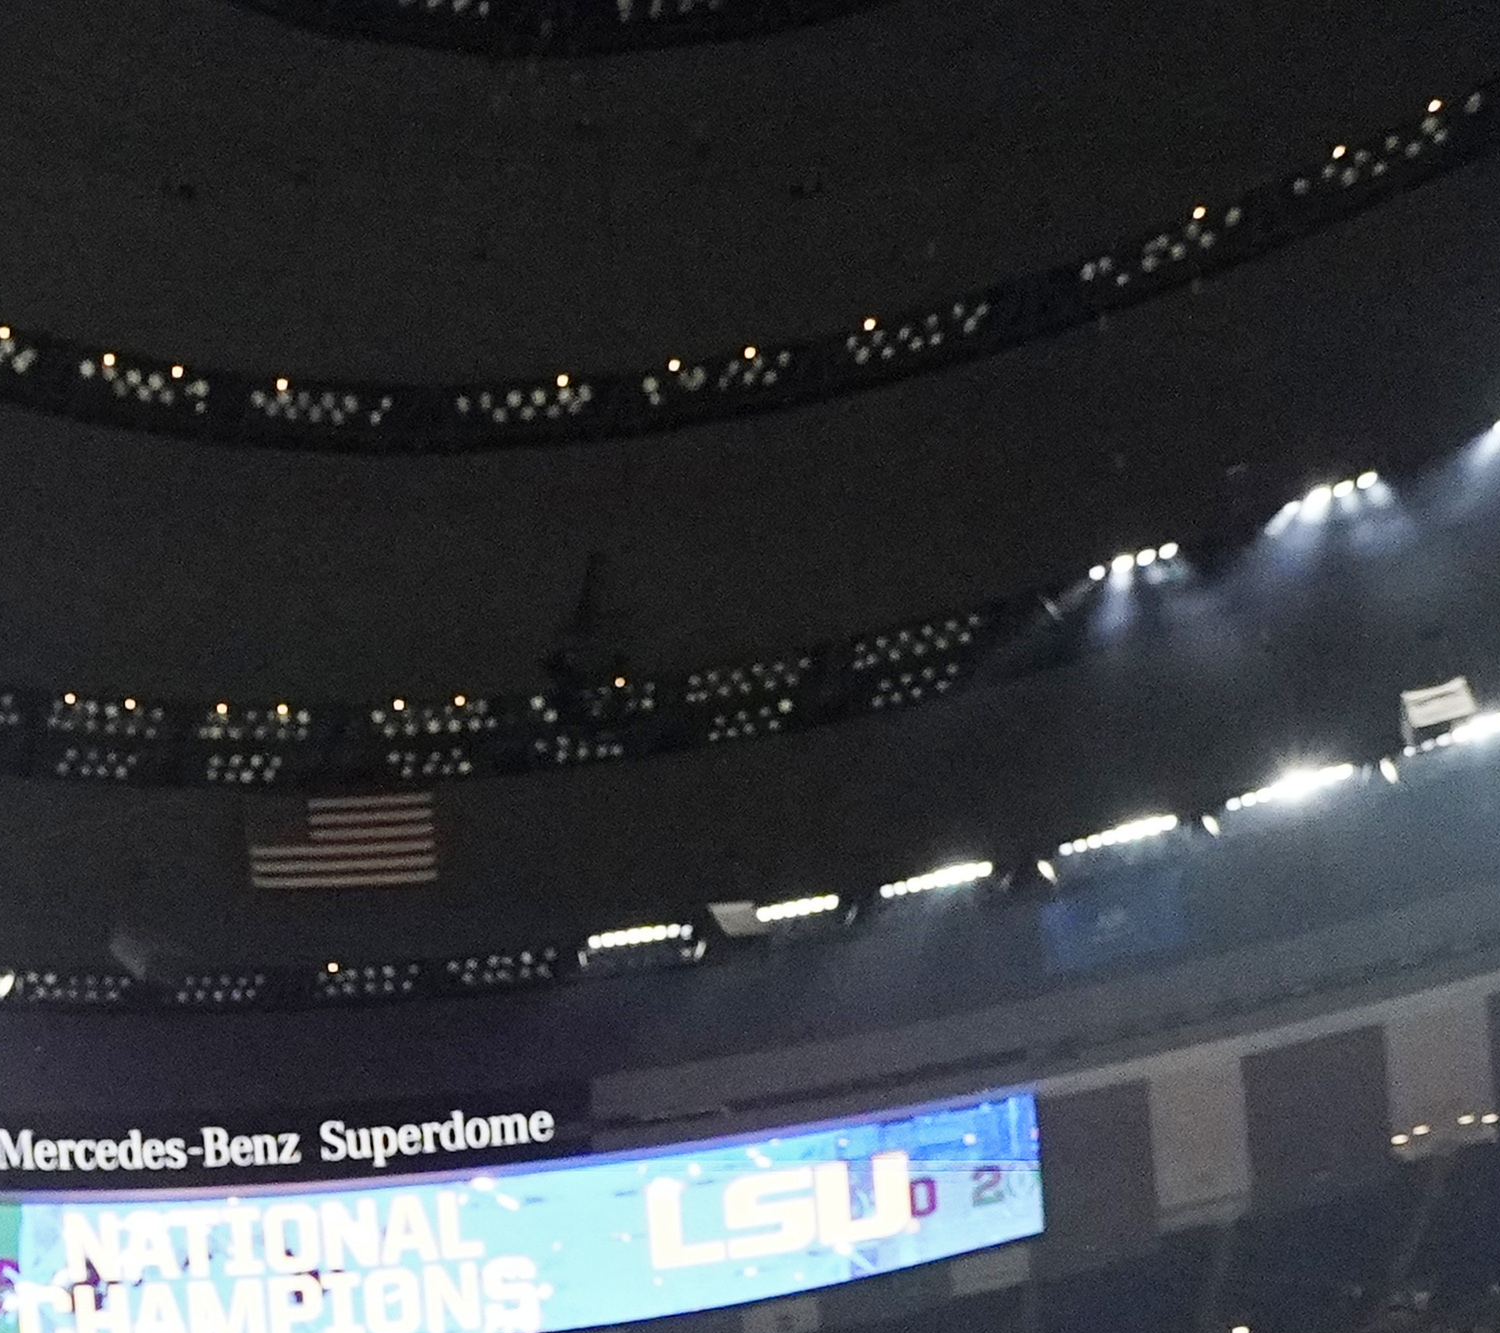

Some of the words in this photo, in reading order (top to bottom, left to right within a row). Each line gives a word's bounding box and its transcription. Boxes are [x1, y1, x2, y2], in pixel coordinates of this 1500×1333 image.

[320, 1109, 556, 1167] Superdome
[62, 1191, 485, 1283] NATIONAL
[646, 1151, 911, 1270] LSU
